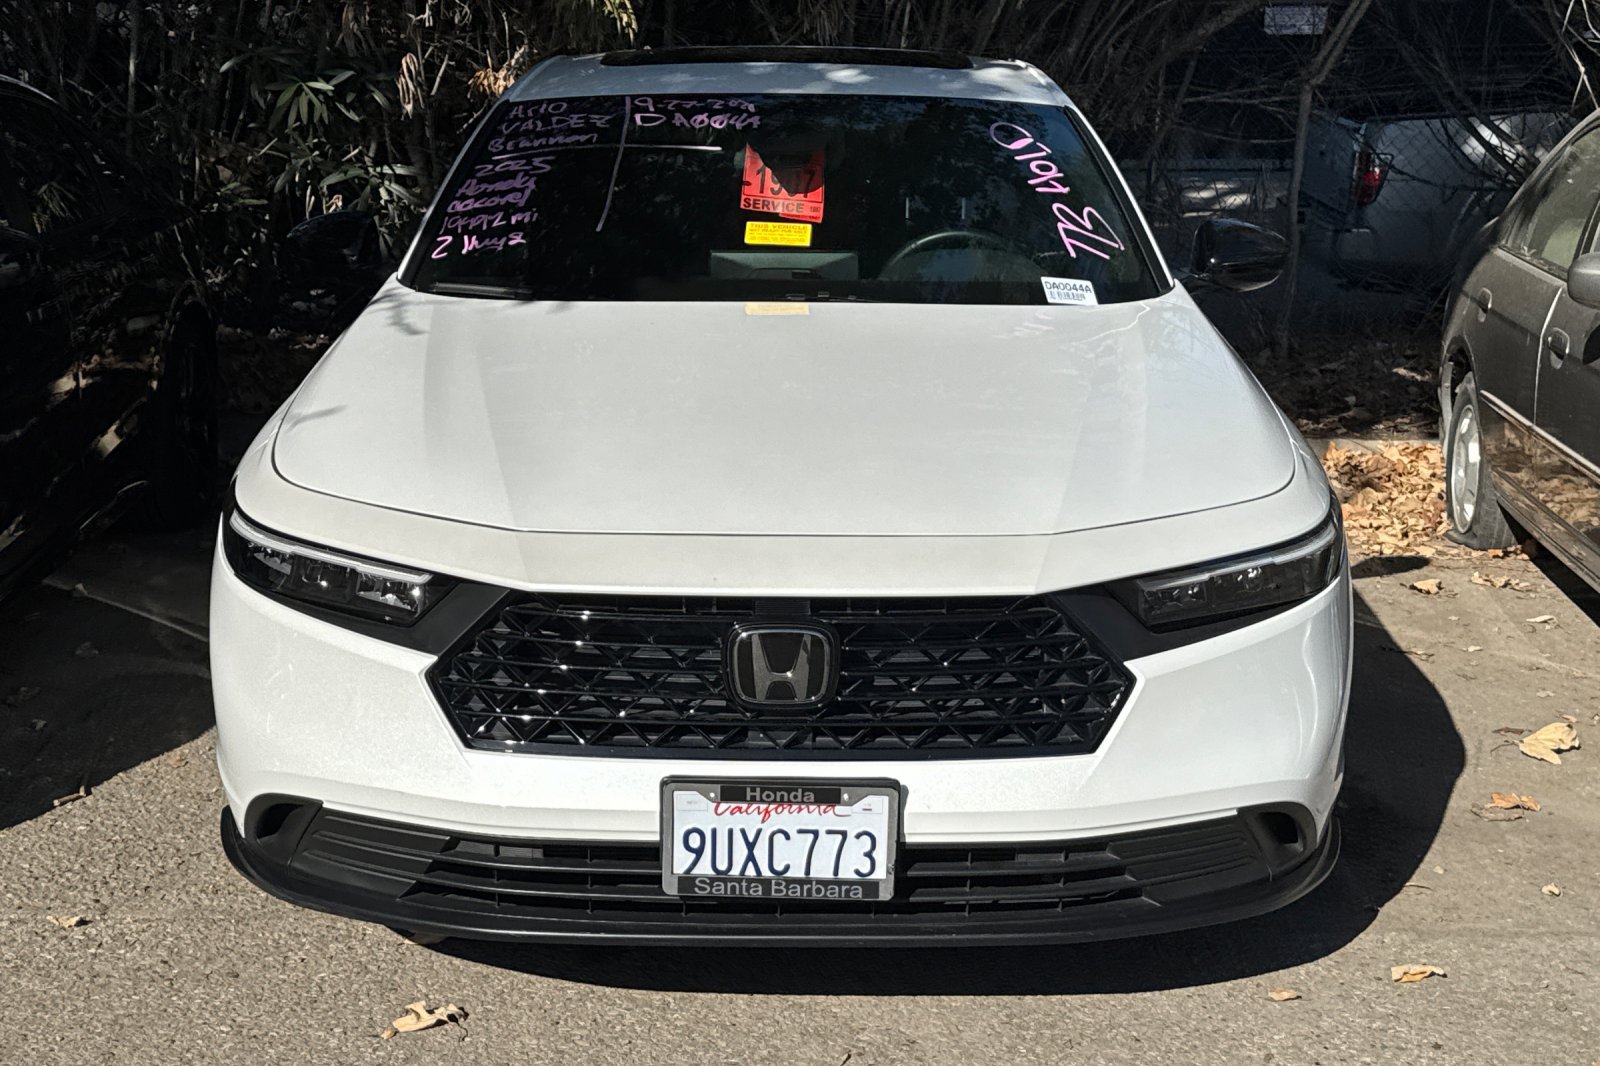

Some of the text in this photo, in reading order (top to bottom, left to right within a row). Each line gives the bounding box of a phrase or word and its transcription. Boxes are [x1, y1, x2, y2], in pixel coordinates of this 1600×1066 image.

[502, 113, 616, 134] VALDEZ
[474, 156, 556, 177] 2025
[989, 122, 1070, 193] HOLD
[743, 198, 805, 213] SERVICE
[432, 236, 453, 258] 2
[1044, 281, 1092, 293] DA0044A
[746, 786, 815, 803] Honda
[713, 800, 852, 824] California
[682, 827, 877, 877] 9UXC773
[694, 877, 863, 898] Santa Barbara
